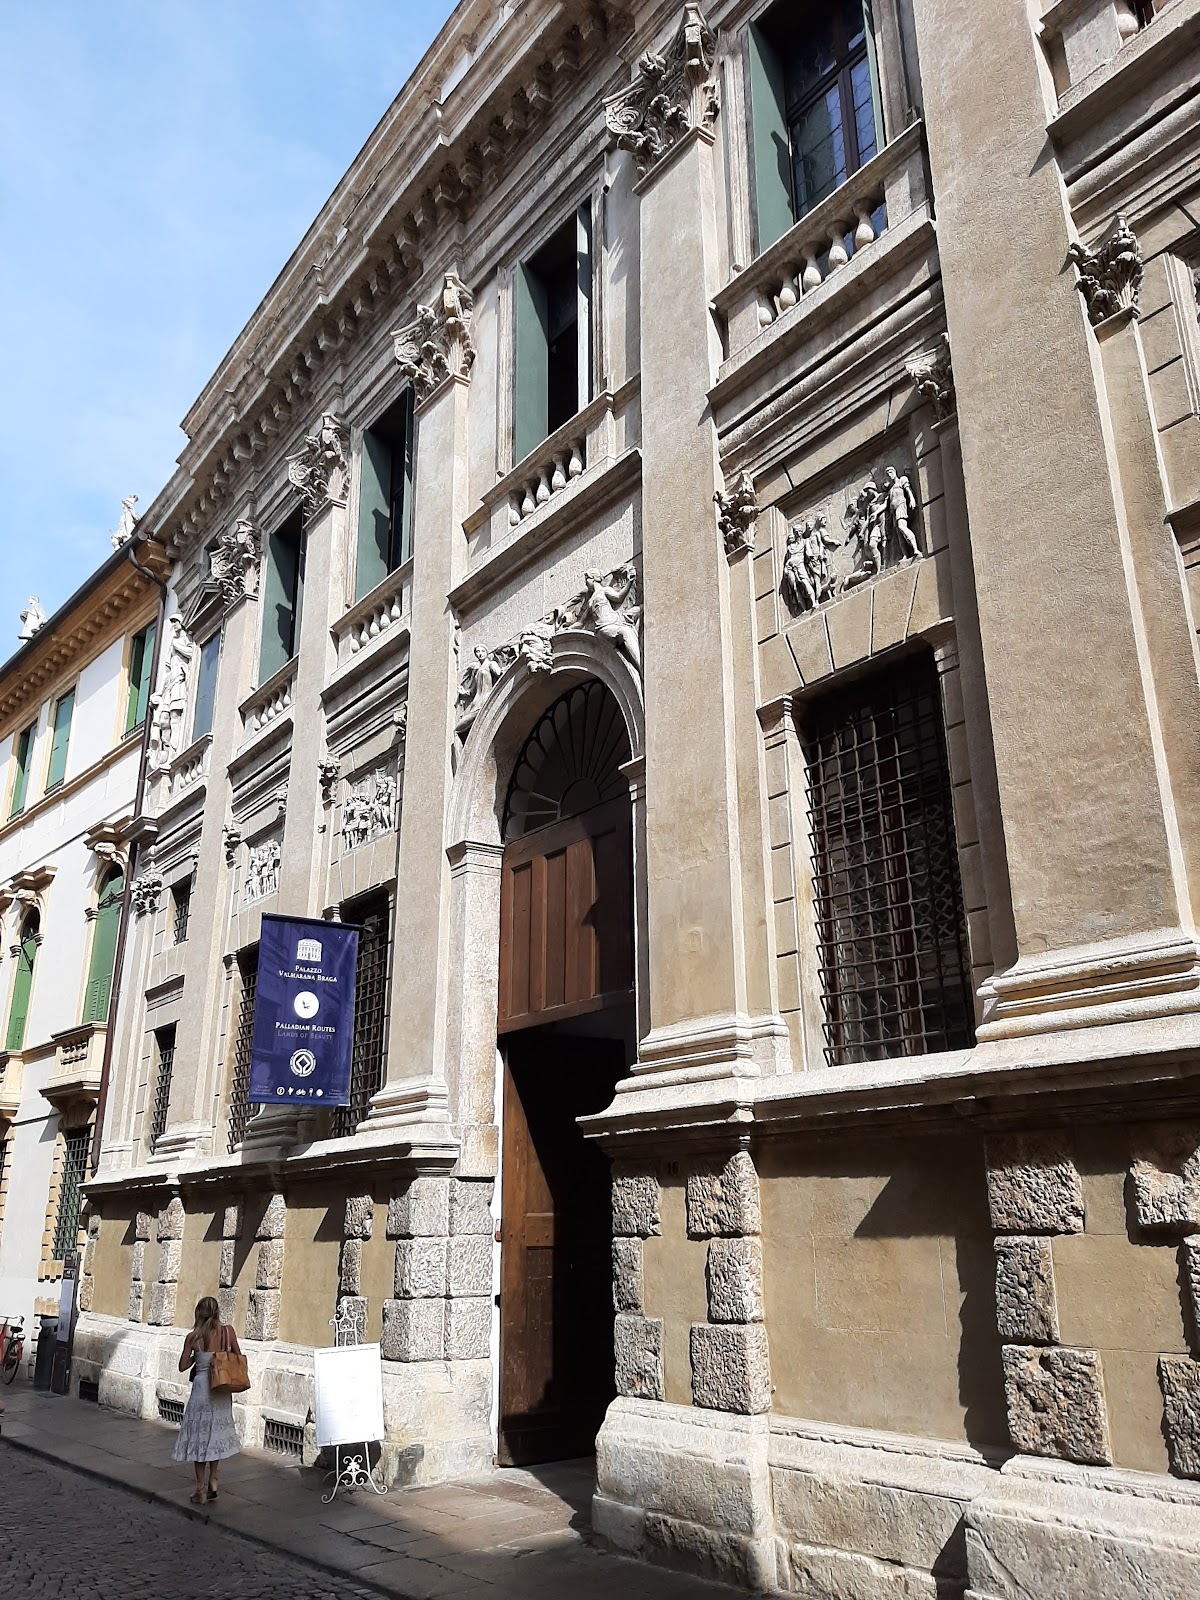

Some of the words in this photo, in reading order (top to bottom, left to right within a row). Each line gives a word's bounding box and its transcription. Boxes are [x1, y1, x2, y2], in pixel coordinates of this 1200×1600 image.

[295, 965, 322, 974] PALAZZO
[278, 970, 316, 981] VALMARANA
[317, 975, 338, 983] BRAGA
[275, 1021, 310, 1031] PALLADIAN
[311, 1025, 336, 1033] ROUTES
[277, 1030, 299, 1038] LANDS
